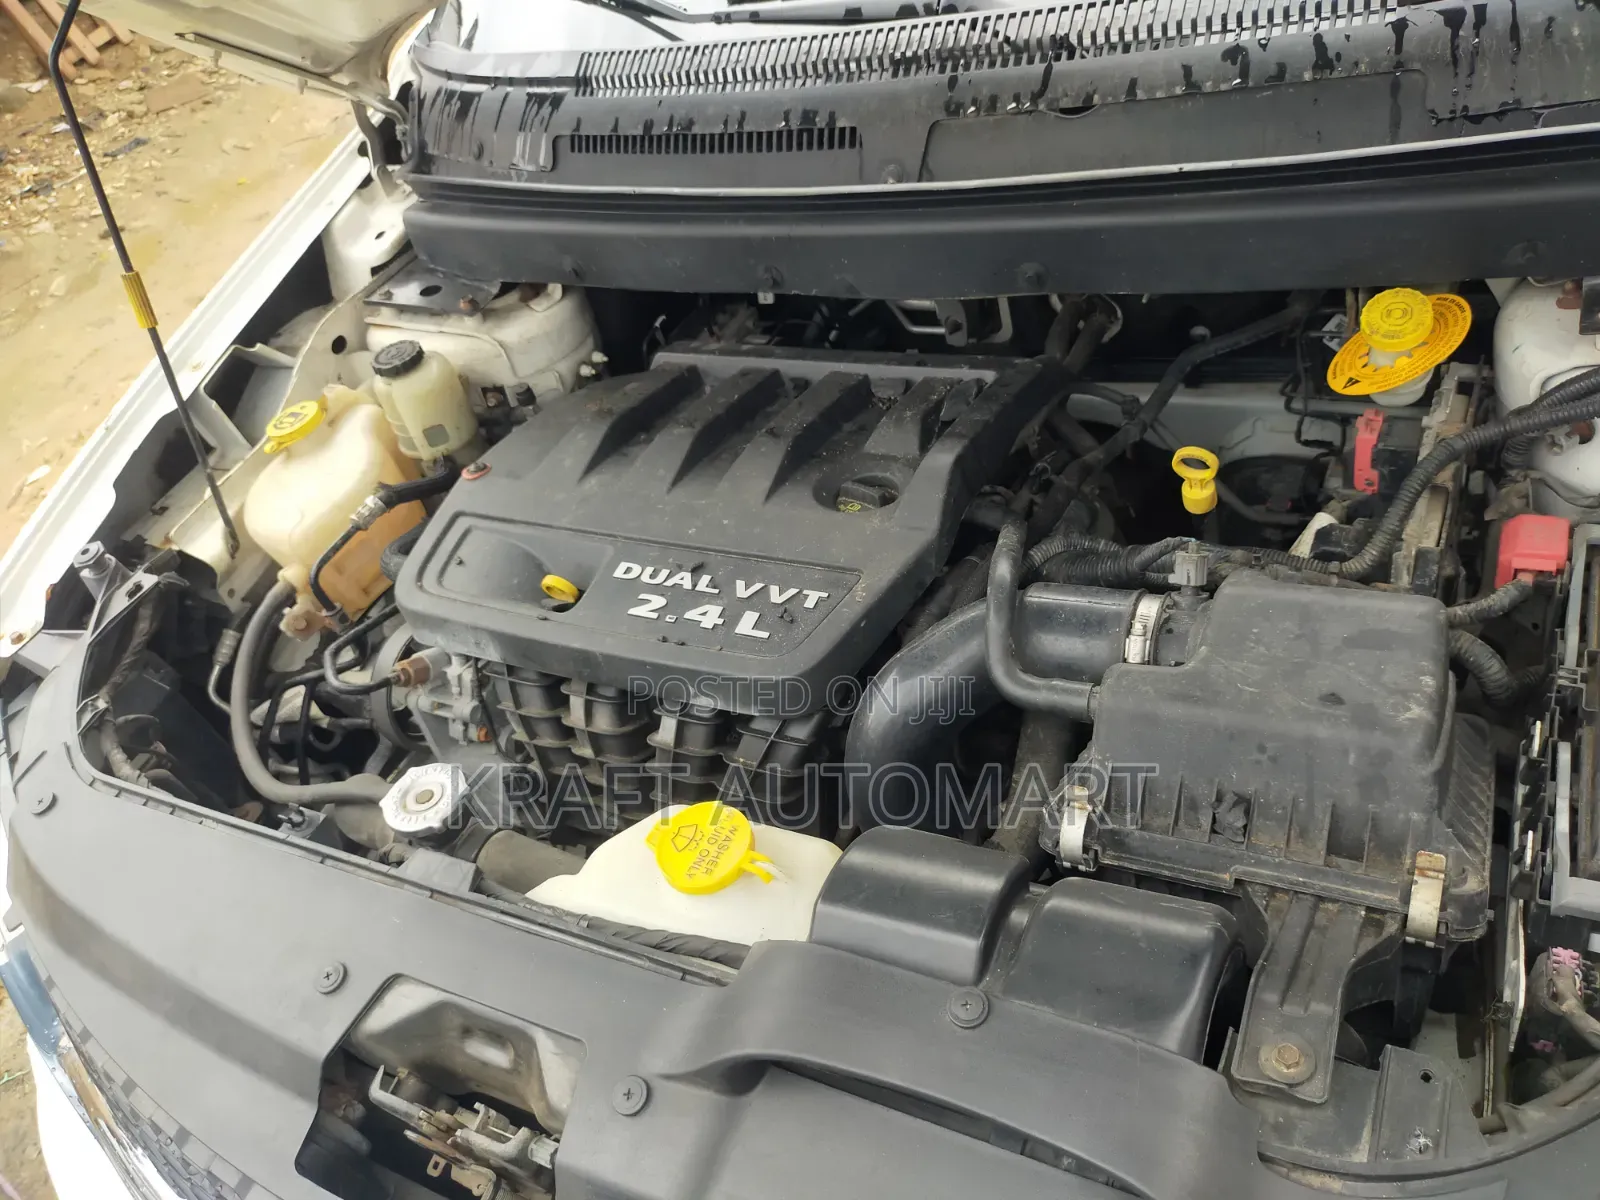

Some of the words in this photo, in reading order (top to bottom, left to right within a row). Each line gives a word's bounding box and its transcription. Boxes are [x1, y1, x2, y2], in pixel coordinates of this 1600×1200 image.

[613, 561, 720, 594] DUAL
[735, 579, 829, 609] VVT
[685, 848, 710, 879] ONLY
[701, 825, 739, 876] WASHER
